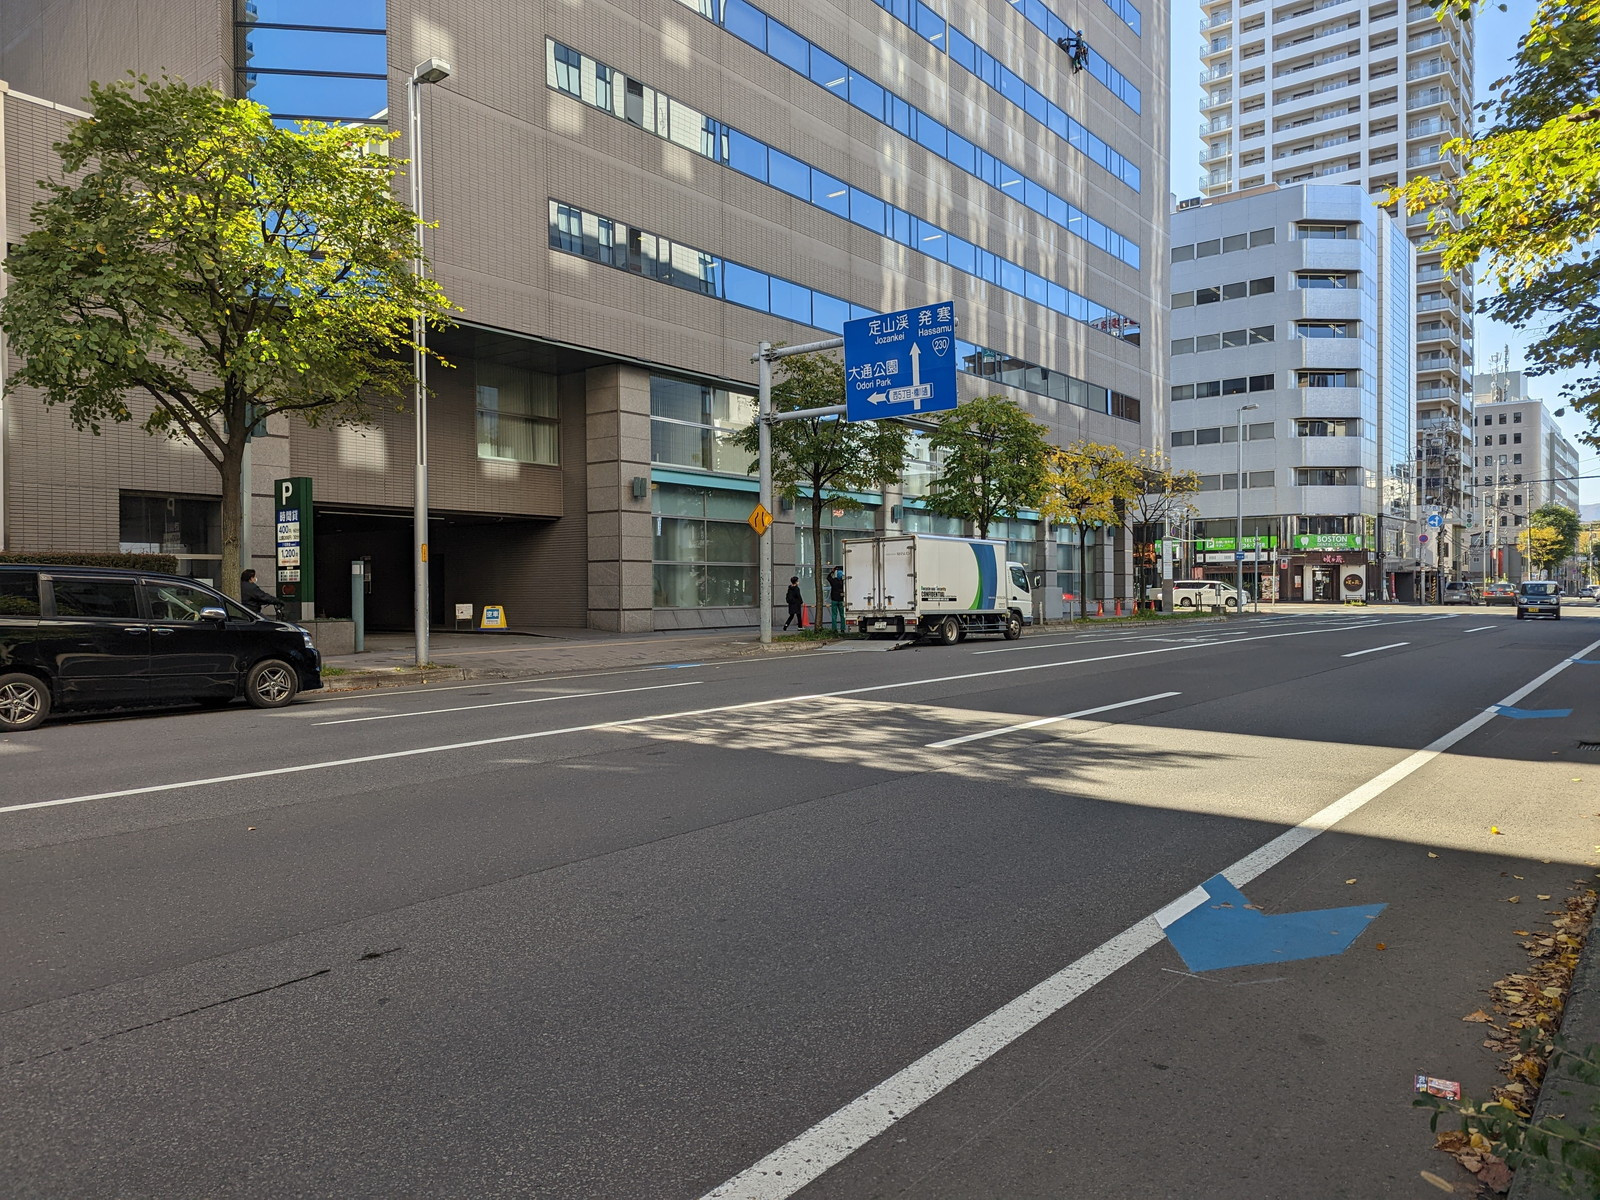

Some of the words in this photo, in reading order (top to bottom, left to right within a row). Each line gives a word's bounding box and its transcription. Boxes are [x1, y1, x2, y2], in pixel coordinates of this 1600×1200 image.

[868, 313, 909, 336] 定山渓
[918, 325, 952, 337] Hassamu
[874, 332, 905, 345] Jozankei
[934, 340, 947, 350] 230
[848, 359, 899, 382] 大通公園
[856, 380, 874, 390] Odori
[876, 378, 892, 388] Park
[282, 481, 293, 506] P
[279, 509, 299, 522] 時間貸
[1317, 535, 1348, 543] BOSTON
